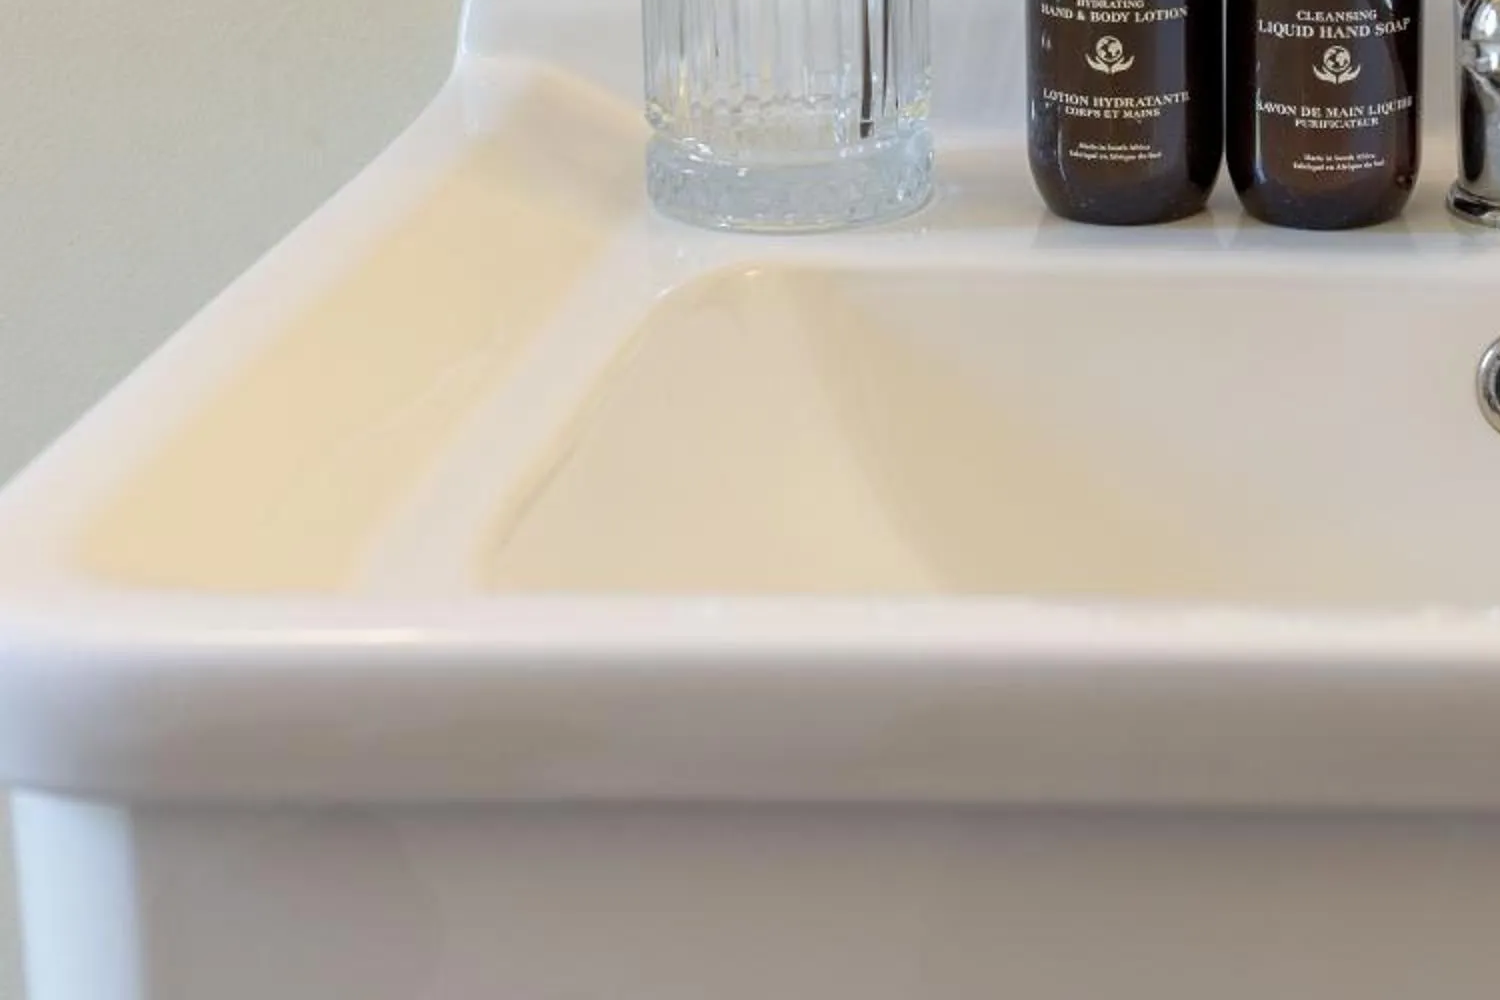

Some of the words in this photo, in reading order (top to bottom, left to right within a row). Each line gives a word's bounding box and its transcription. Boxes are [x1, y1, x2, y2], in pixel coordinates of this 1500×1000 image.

[1041, 3, 1073, 19] HAND
[1077, 10, 1086, 21] &
[1090, 11, 1130, 23] BODY
[1135, 6, 1188, 23] LOTION
[1296, 10, 1377, 21] CLEANSING
[1258, 19, 1314, 38] LIQUID
[1319, 25, 1370, 38] HAND
[1374, 17, 1410, 36] SOAP
[1043, 87, 1089, 105] LOTION
[1093, 91, 1189, 108] HYDRATANTE
[1065, 105, 1100, 117] CORPS
[1103, 108, 1118, 118] ET
[1122, 107, 1160, 118] MAINS
[1301, 104, 1321, 117] DE
[1326, 105, 1365, 117] MAIN
[1295, 117, 1379, 129] PURIFICATEUR
